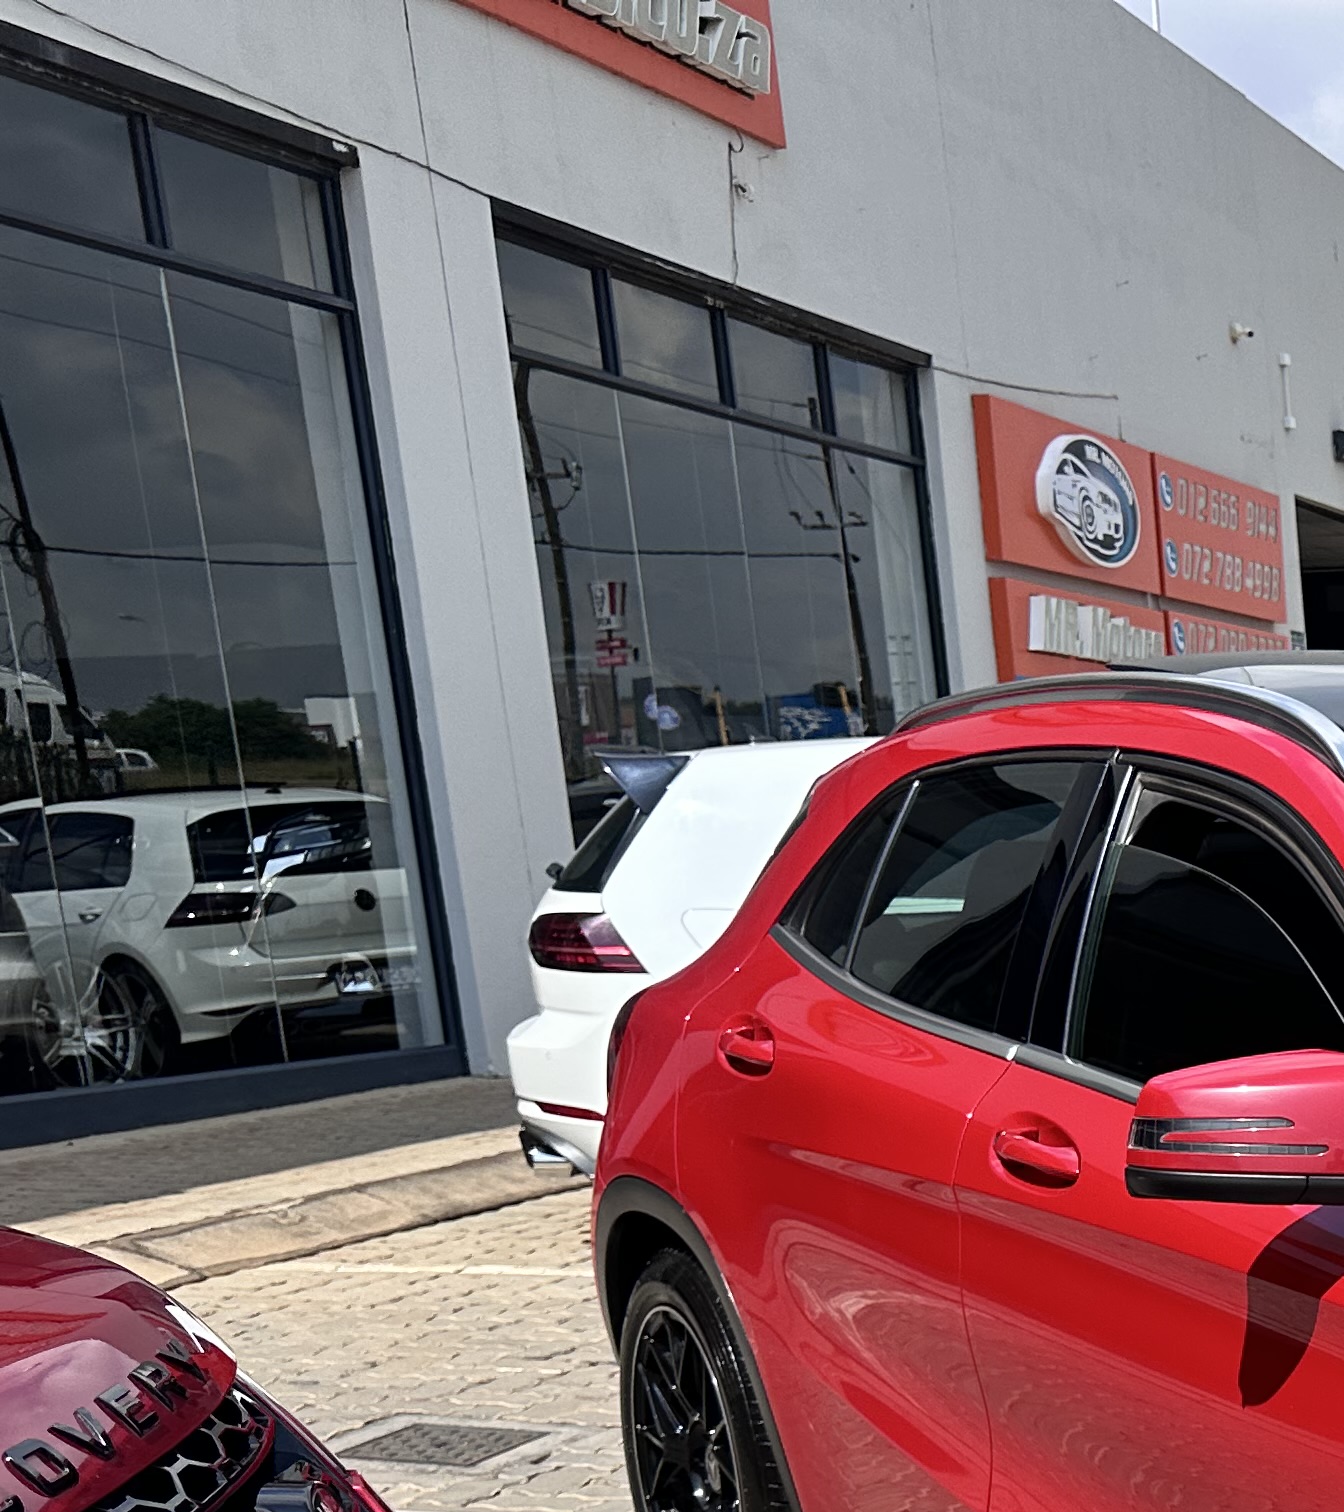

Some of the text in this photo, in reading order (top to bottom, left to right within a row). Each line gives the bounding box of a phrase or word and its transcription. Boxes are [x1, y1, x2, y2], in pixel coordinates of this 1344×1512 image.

[1176, 478, 1208, 523] 012
[1182, 543, 1212, 585] 072
[1215, 551, 1243, 592] 788
